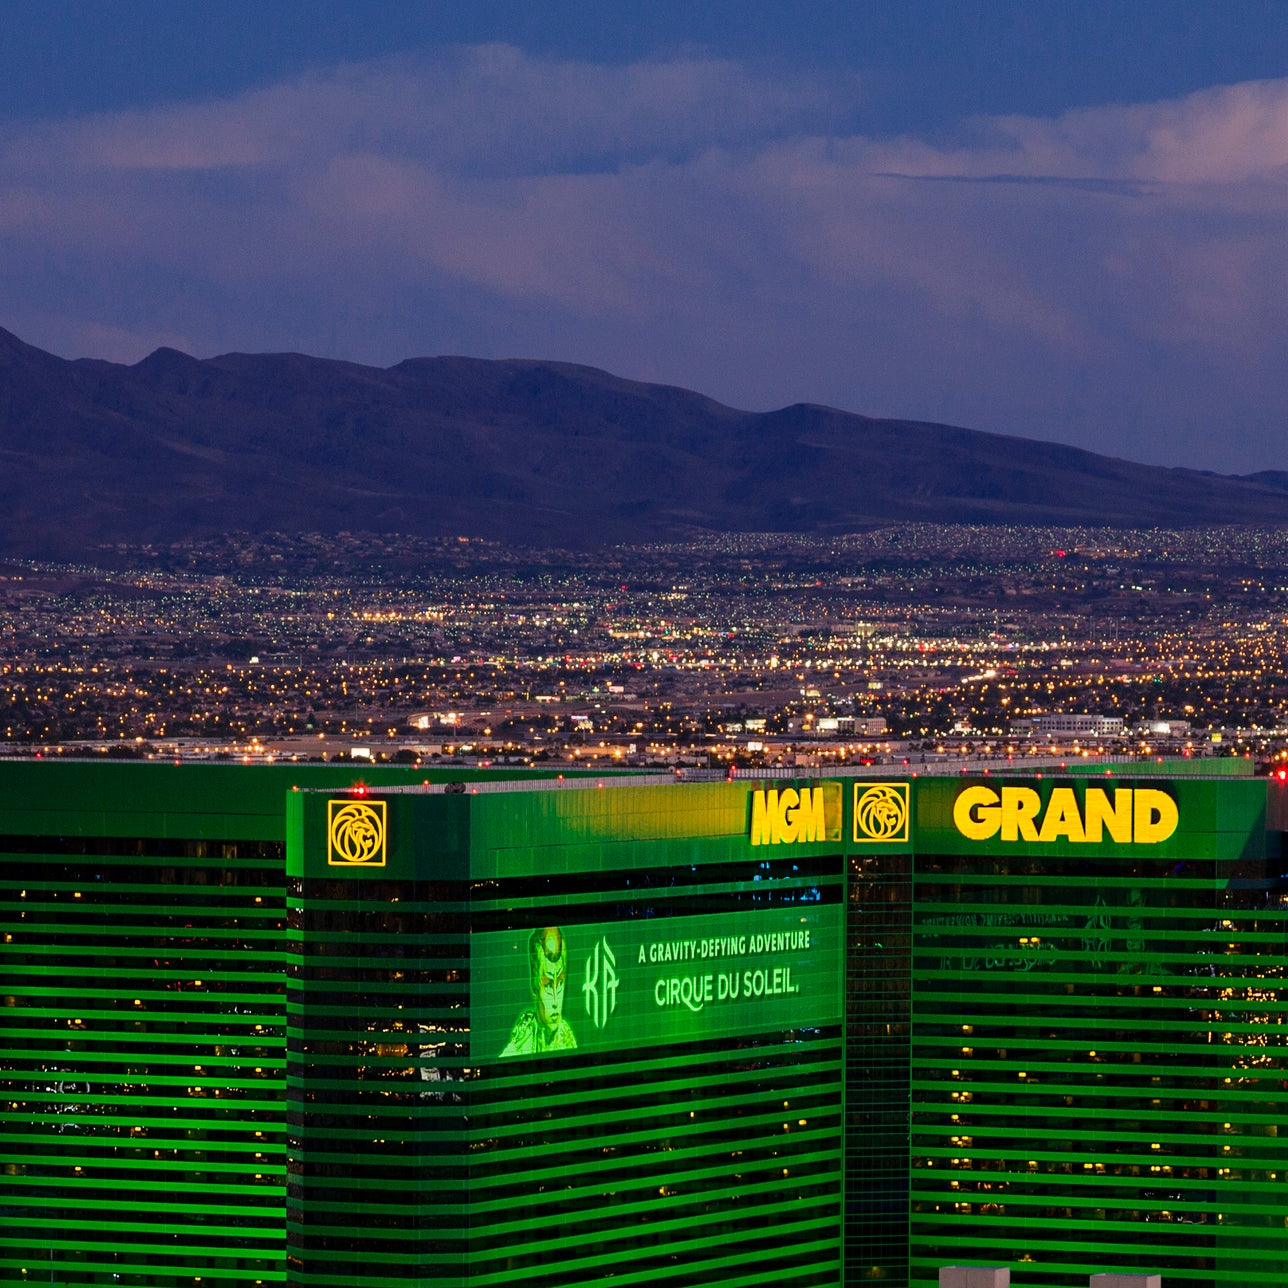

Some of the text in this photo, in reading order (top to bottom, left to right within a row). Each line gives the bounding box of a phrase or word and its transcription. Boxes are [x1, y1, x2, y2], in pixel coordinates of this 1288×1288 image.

[751, 787, 826, 846] MGM
[953, 785, 1179, 844] GRAND
[638, 930, 810, 964] A GRAVITY-DEFYING ADVENTURE
[655, 975, 713, 1012] CIRQUE
[718, 972, 740, 1000] DU
